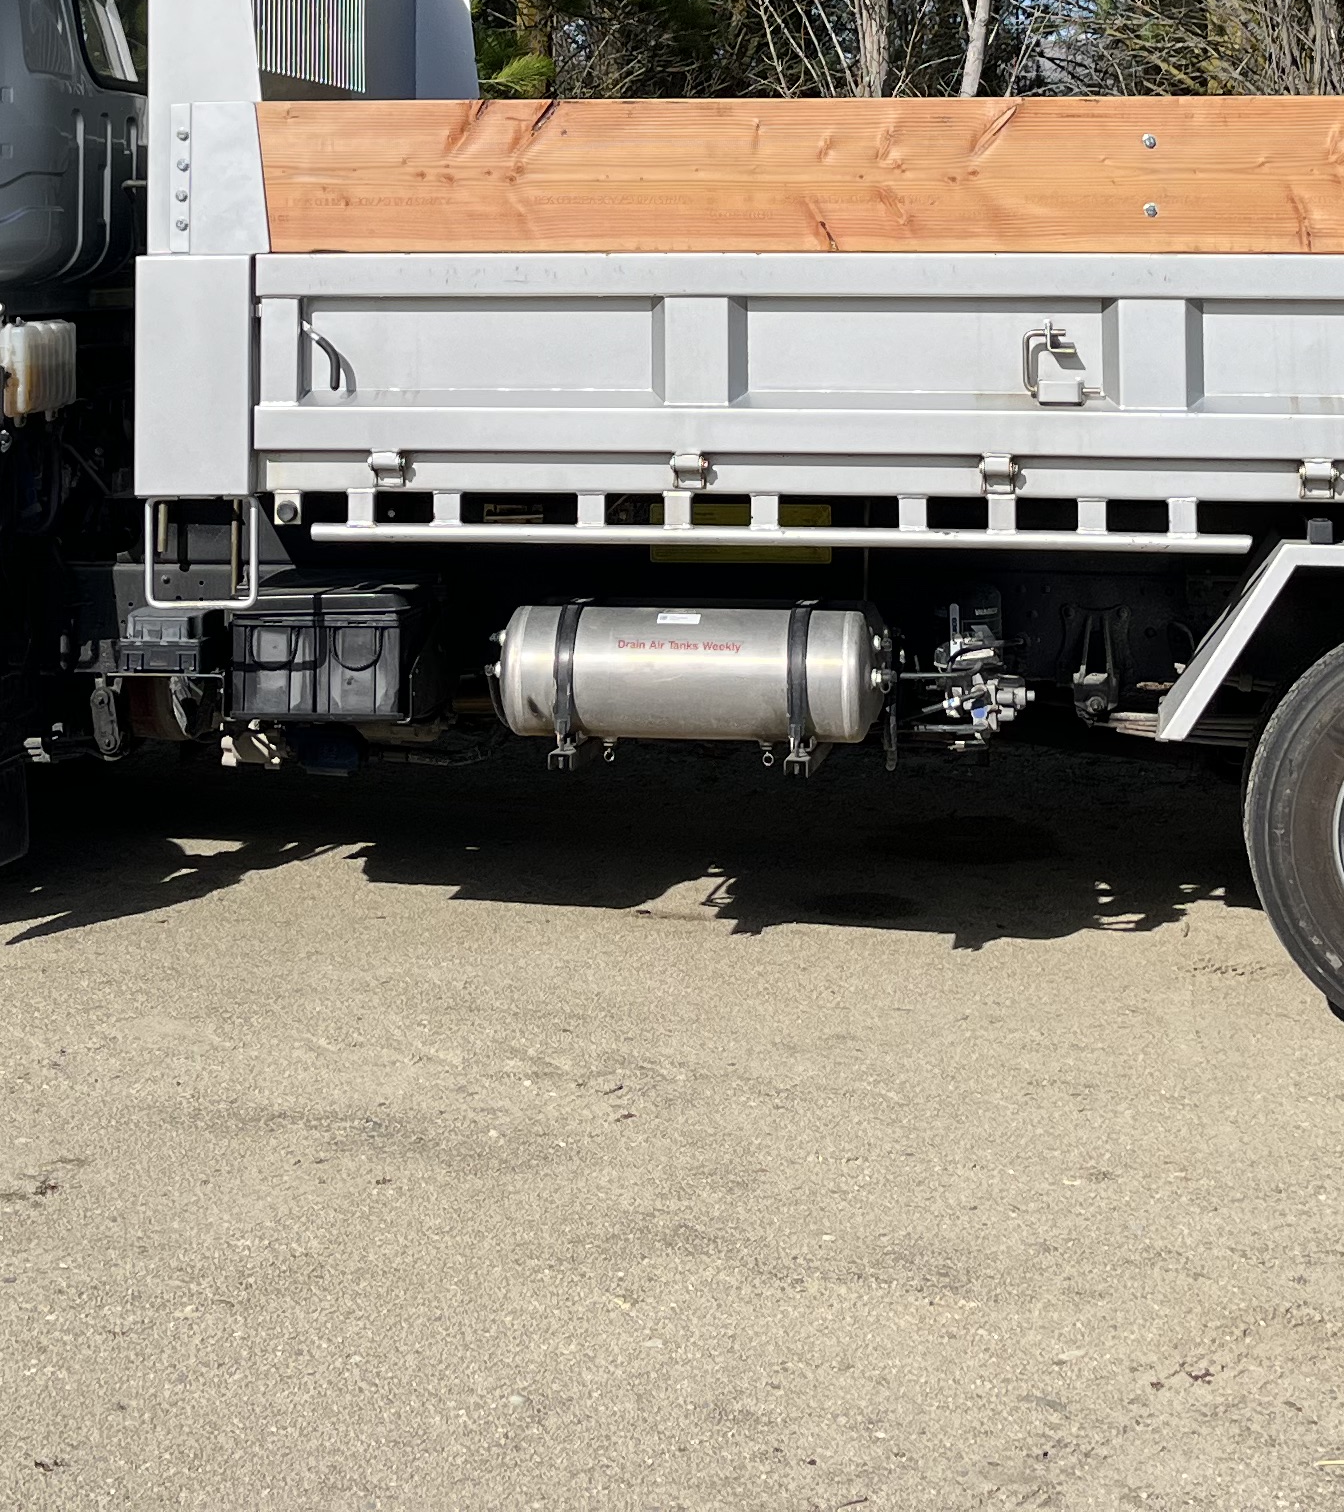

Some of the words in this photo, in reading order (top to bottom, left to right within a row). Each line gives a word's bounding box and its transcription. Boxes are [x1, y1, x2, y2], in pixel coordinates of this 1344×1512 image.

[617, 639, 646, 649] Drain
[649, 640, 665, 650] Air
[668, 640, 699, 651] Tanks
[702, 641, 741, 653] Weekly
